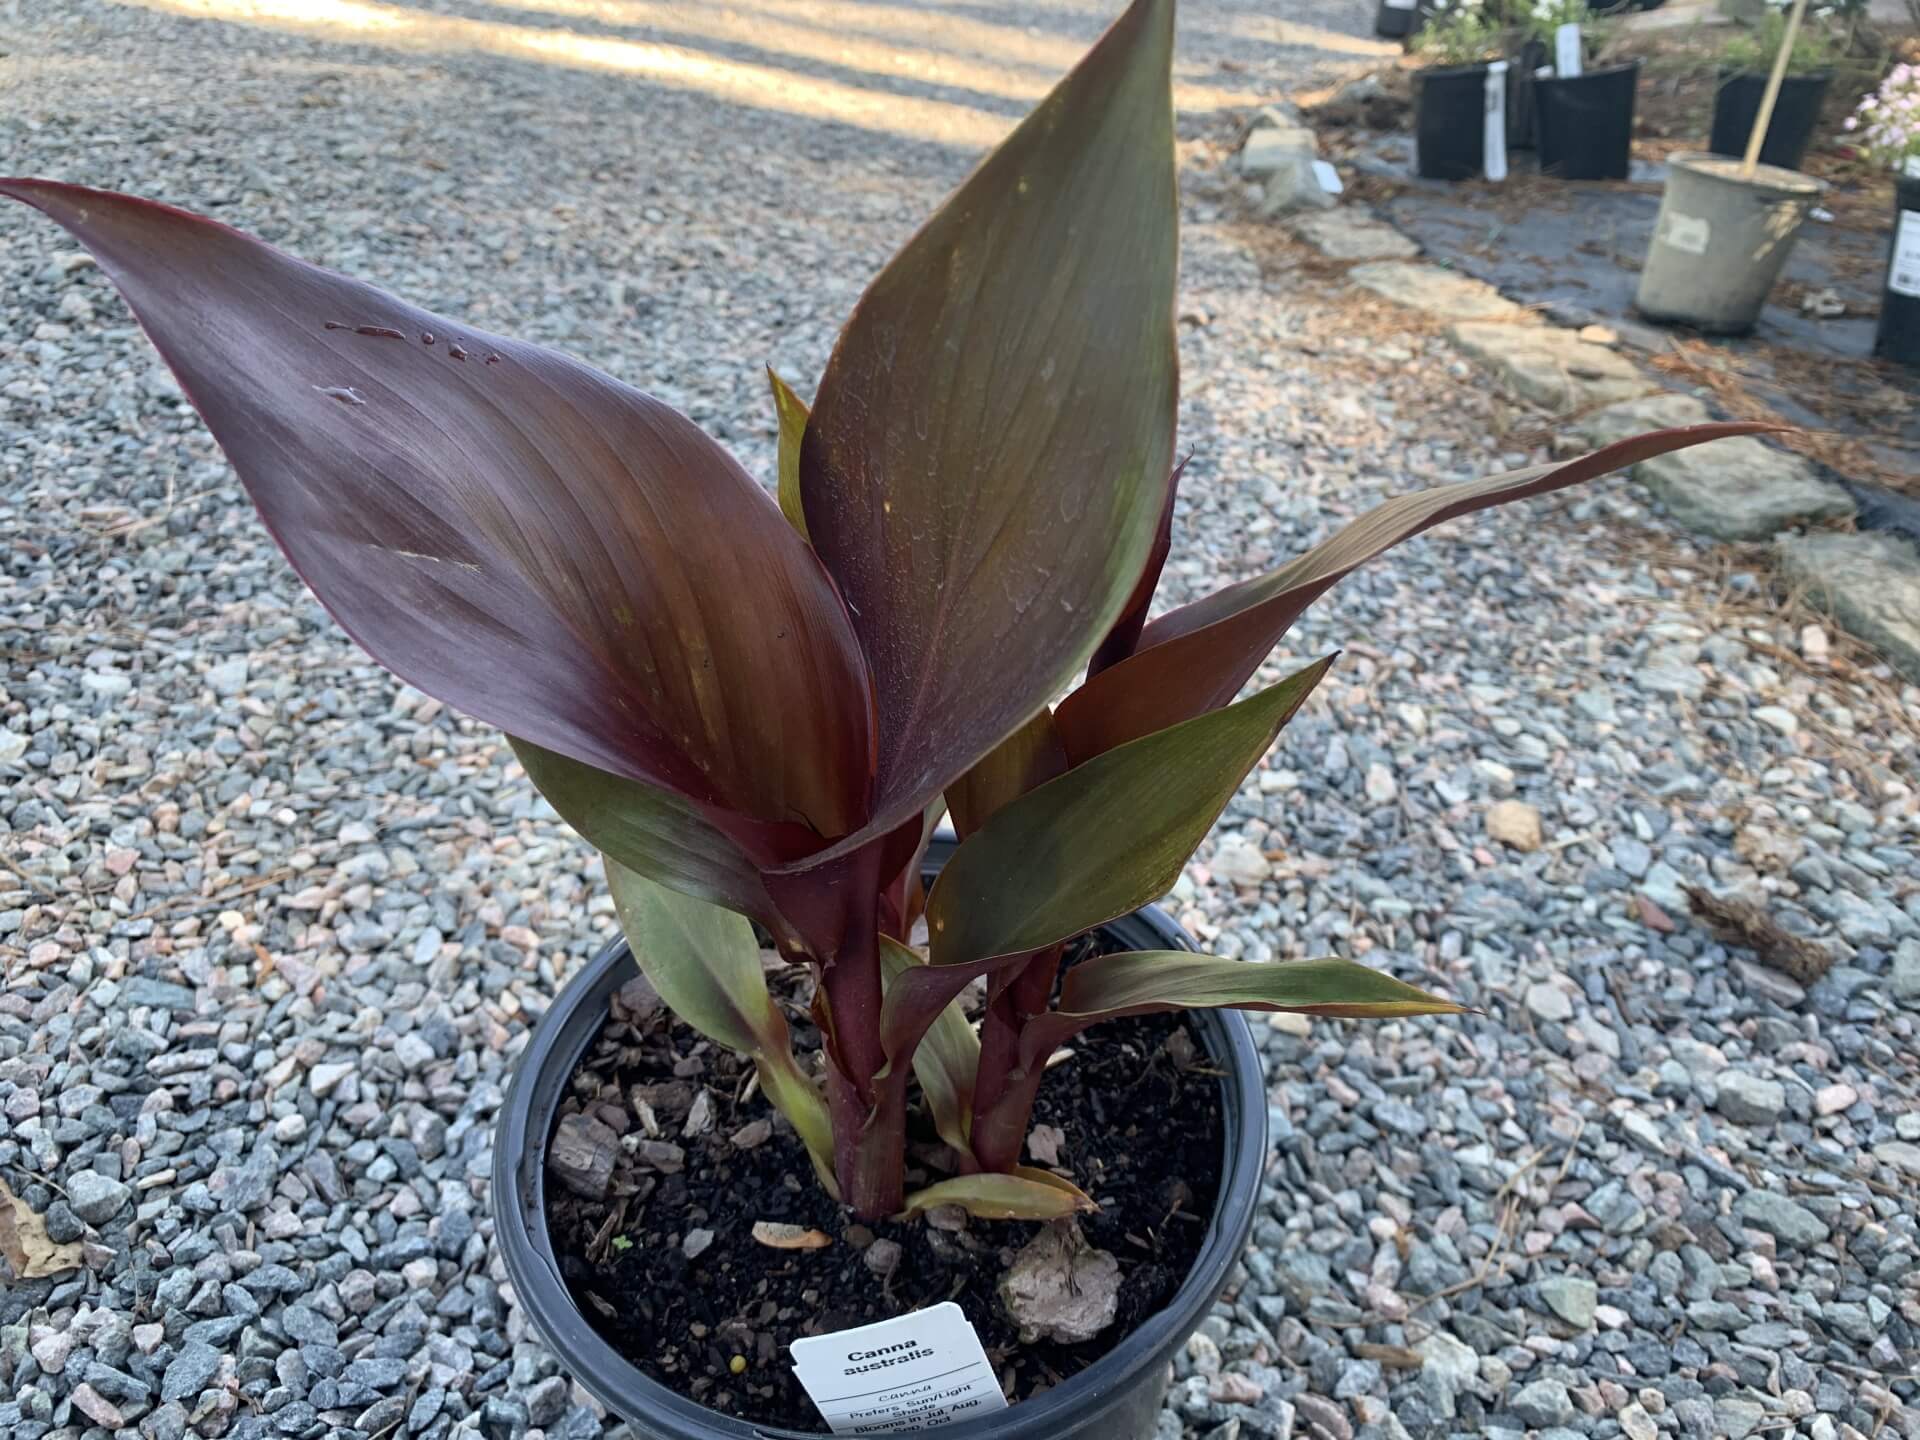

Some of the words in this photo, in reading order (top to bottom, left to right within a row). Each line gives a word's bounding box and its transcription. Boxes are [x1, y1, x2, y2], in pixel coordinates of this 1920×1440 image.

[844, 1347, 934, 1375] australis
[847, 1339, 917, 1362] Canna
[849, 1405, 900, 1419] Prefers
[906, 1384, 972, 1407] Sun/Light
[892, 1403, 936, 1418] Shade
[854, 1420, 906, 1433] Blooms
[908, 1415, 922, 1423] in
